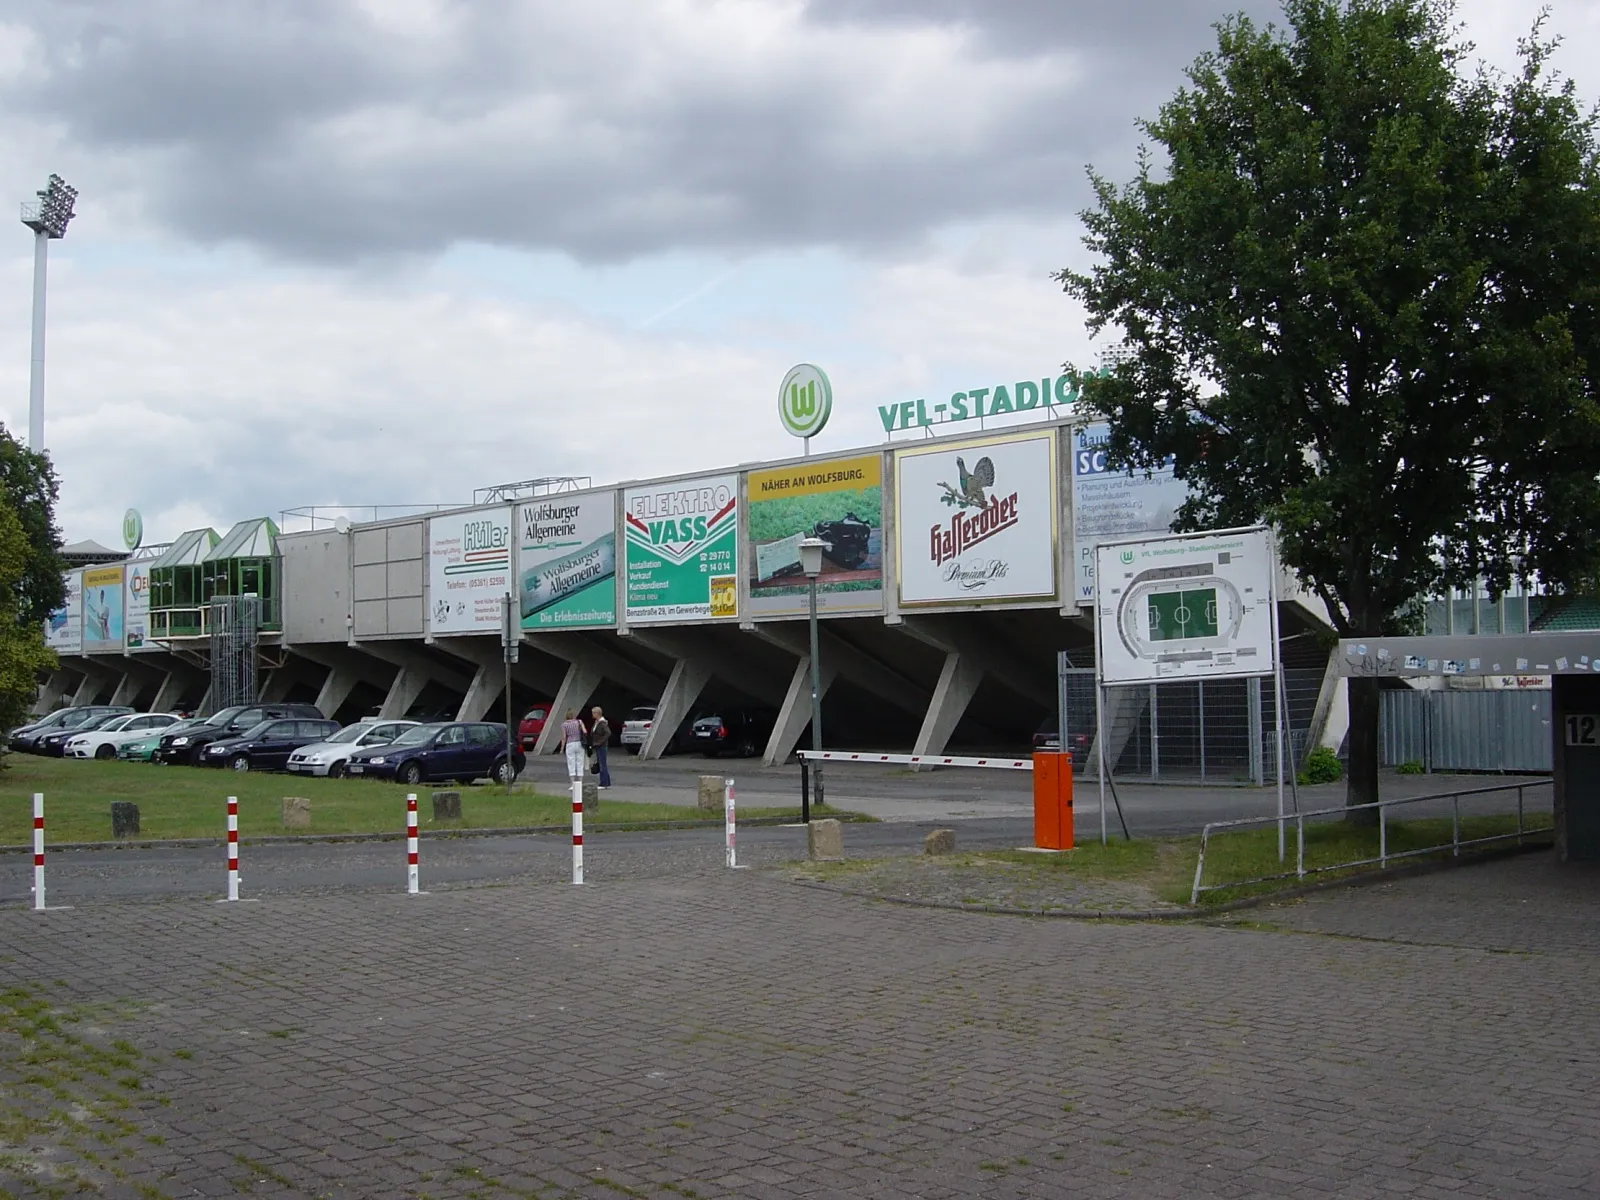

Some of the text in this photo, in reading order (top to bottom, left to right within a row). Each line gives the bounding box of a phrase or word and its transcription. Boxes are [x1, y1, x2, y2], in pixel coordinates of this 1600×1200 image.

[761, 469, 865, 491] NÄHER AN WOLFSBURG.
[1082, 482, 1108, 493] Planung
[1110, 480, 1123, 489] und
[632, 485, 730, 519] ELEKTRO
[524, 504, 580, 523] Wolfsburger
[464, 521, 508, 551] Hüller
[525, 523, 576, 544] Allgemeine
[648, 516, 708, 545] VASS
[543, 548, 600, 580] Wolfsburger
[629, 560, 662, 570] Installation
[549, 562, 601, 595] Allgemeine
[629, 571, 652, 580] Verkauf
[629, 581, 670, 591] Kundendienst
[540, 609, 614, 622] Die Erlebniszeitung.
[627, 606, 657, 616] Benzstraße
[668, 606, 676, 614] im
[1567, 716, 1596, 744] 12
